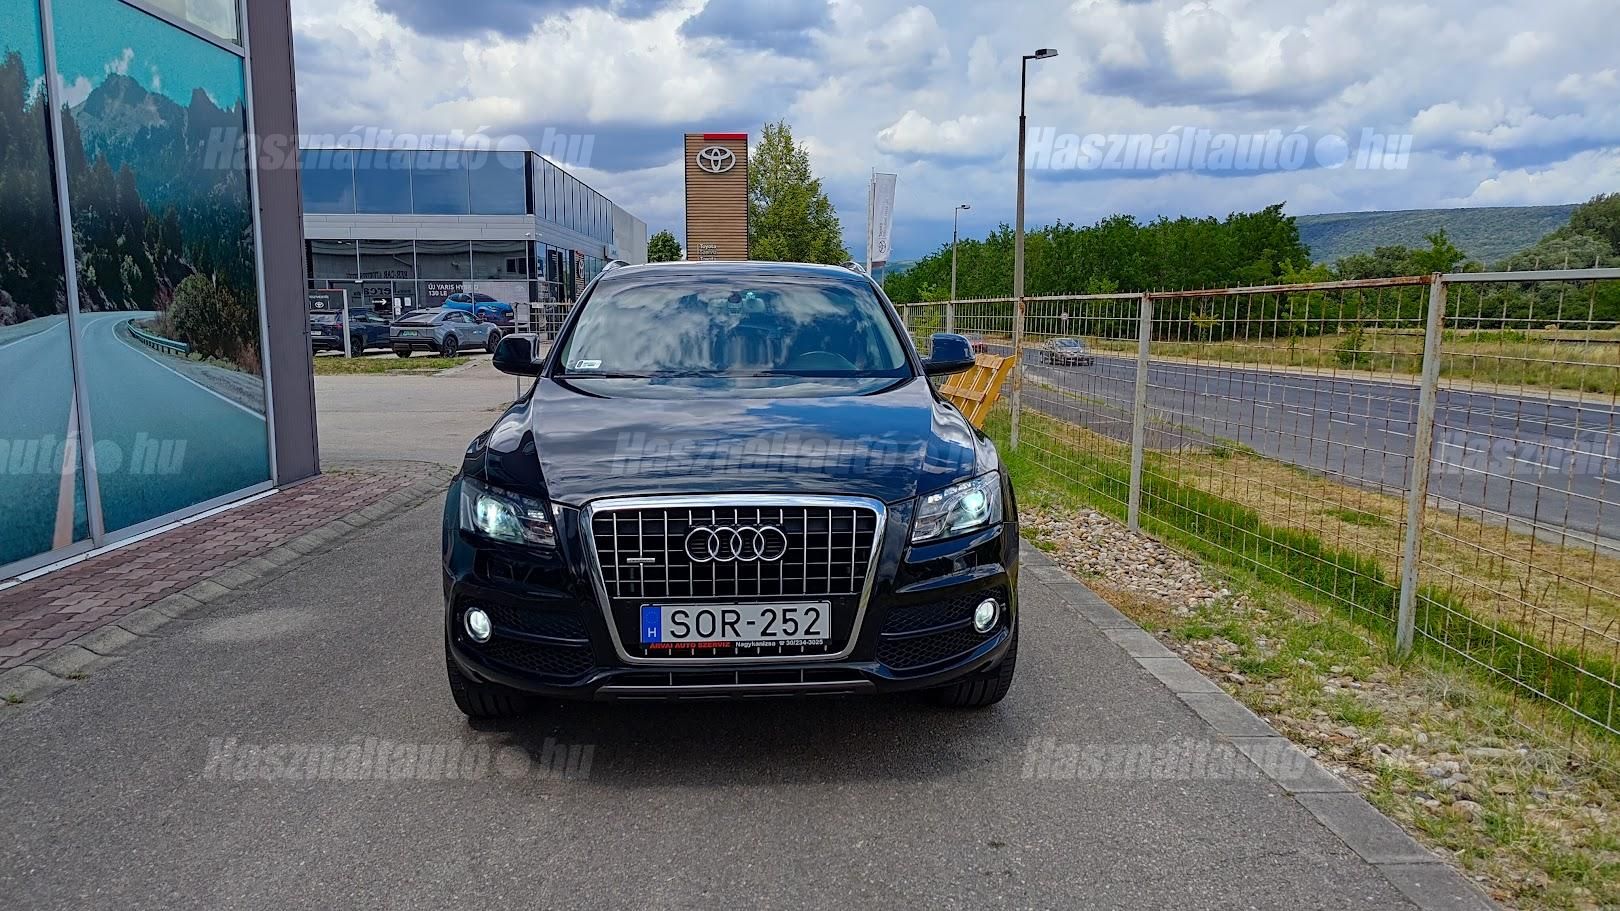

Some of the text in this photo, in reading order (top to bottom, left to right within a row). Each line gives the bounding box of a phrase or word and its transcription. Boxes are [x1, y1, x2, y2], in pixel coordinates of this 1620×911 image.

[670, 607, 821, 639] SOR-252
[647, 628, 657, 638] H
[735, 640, 776, 649] Nagykanizsa
